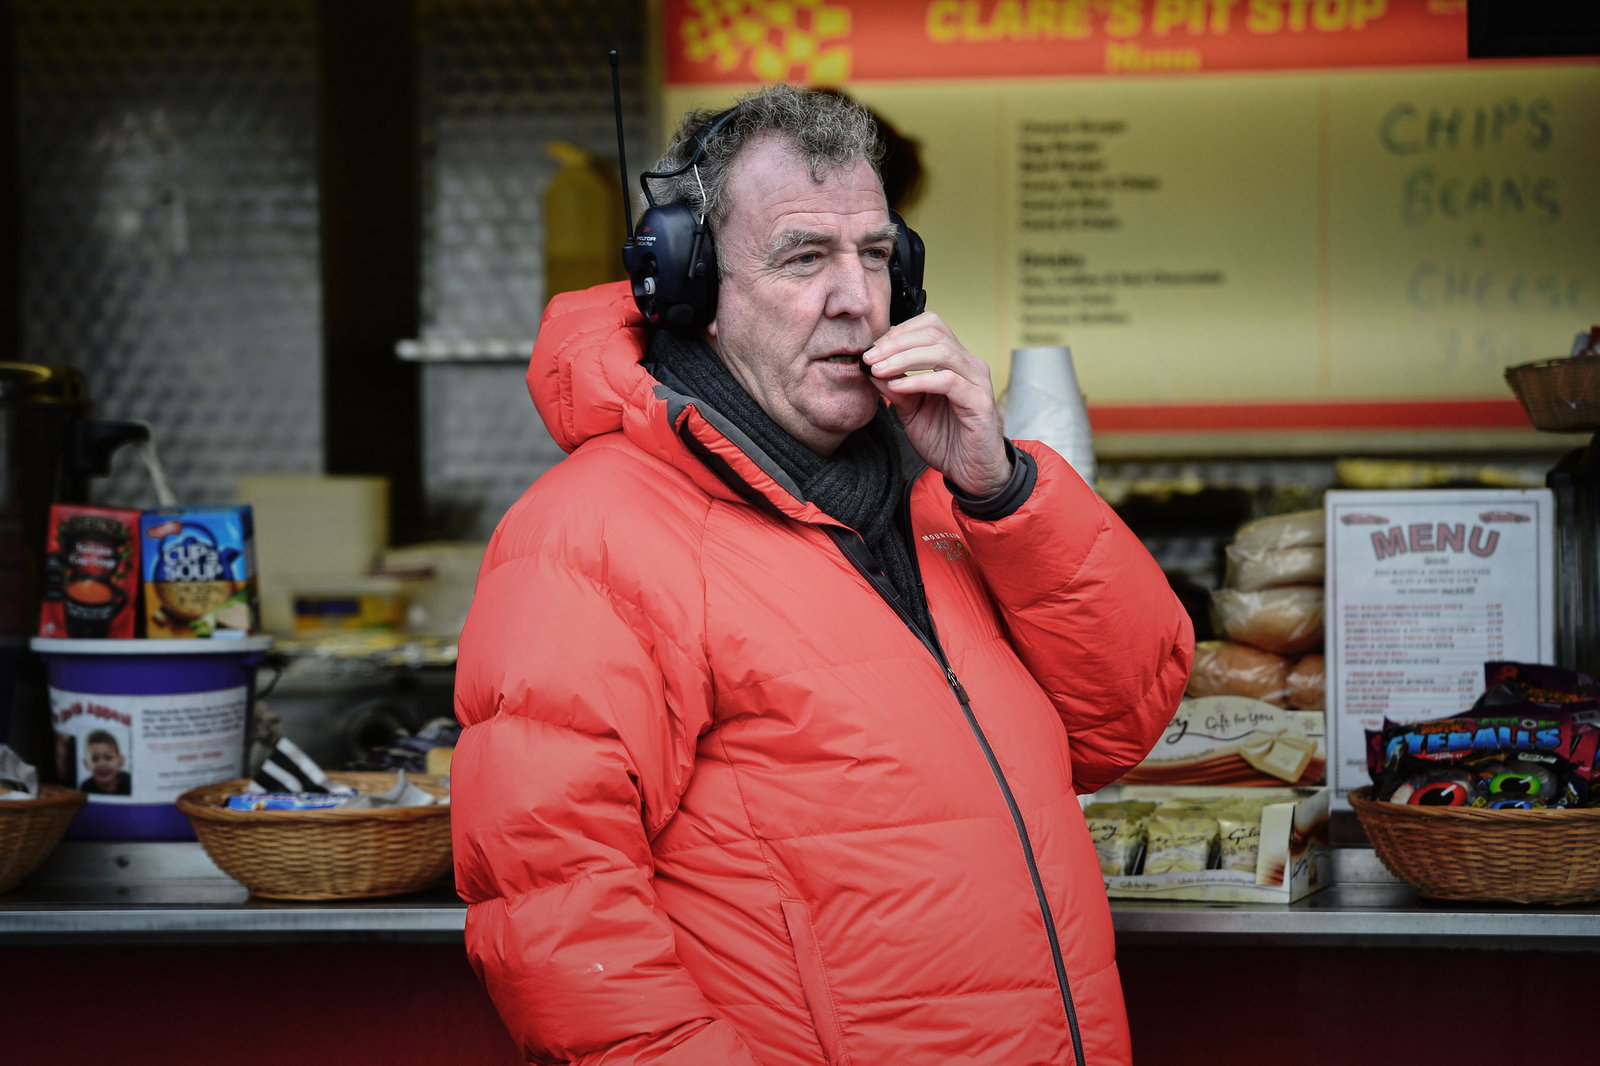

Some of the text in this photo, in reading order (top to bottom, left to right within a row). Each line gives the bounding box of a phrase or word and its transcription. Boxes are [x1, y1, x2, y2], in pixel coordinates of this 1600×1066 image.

[928, 0, 1141, 41] CLARE'S
[1152, 0, 1234, 36] PIT
[1248, 0, 1387, 34] STOP
[1379, 97, 1554, 156] CHIPS
[1406, 259, 1584, 313] CHEESE
[163, 544, 208, 565] CUP
[1370, 522, 1500, 561] MENU
[164, 560, 224, 581] SOUP
[1205, 713, 1230, 734] Gift
[1234, 713, 1247, 726] for
[1249, 711, 1274, 726] You
[1385, 727, 1561, 761] EYEBALLS
